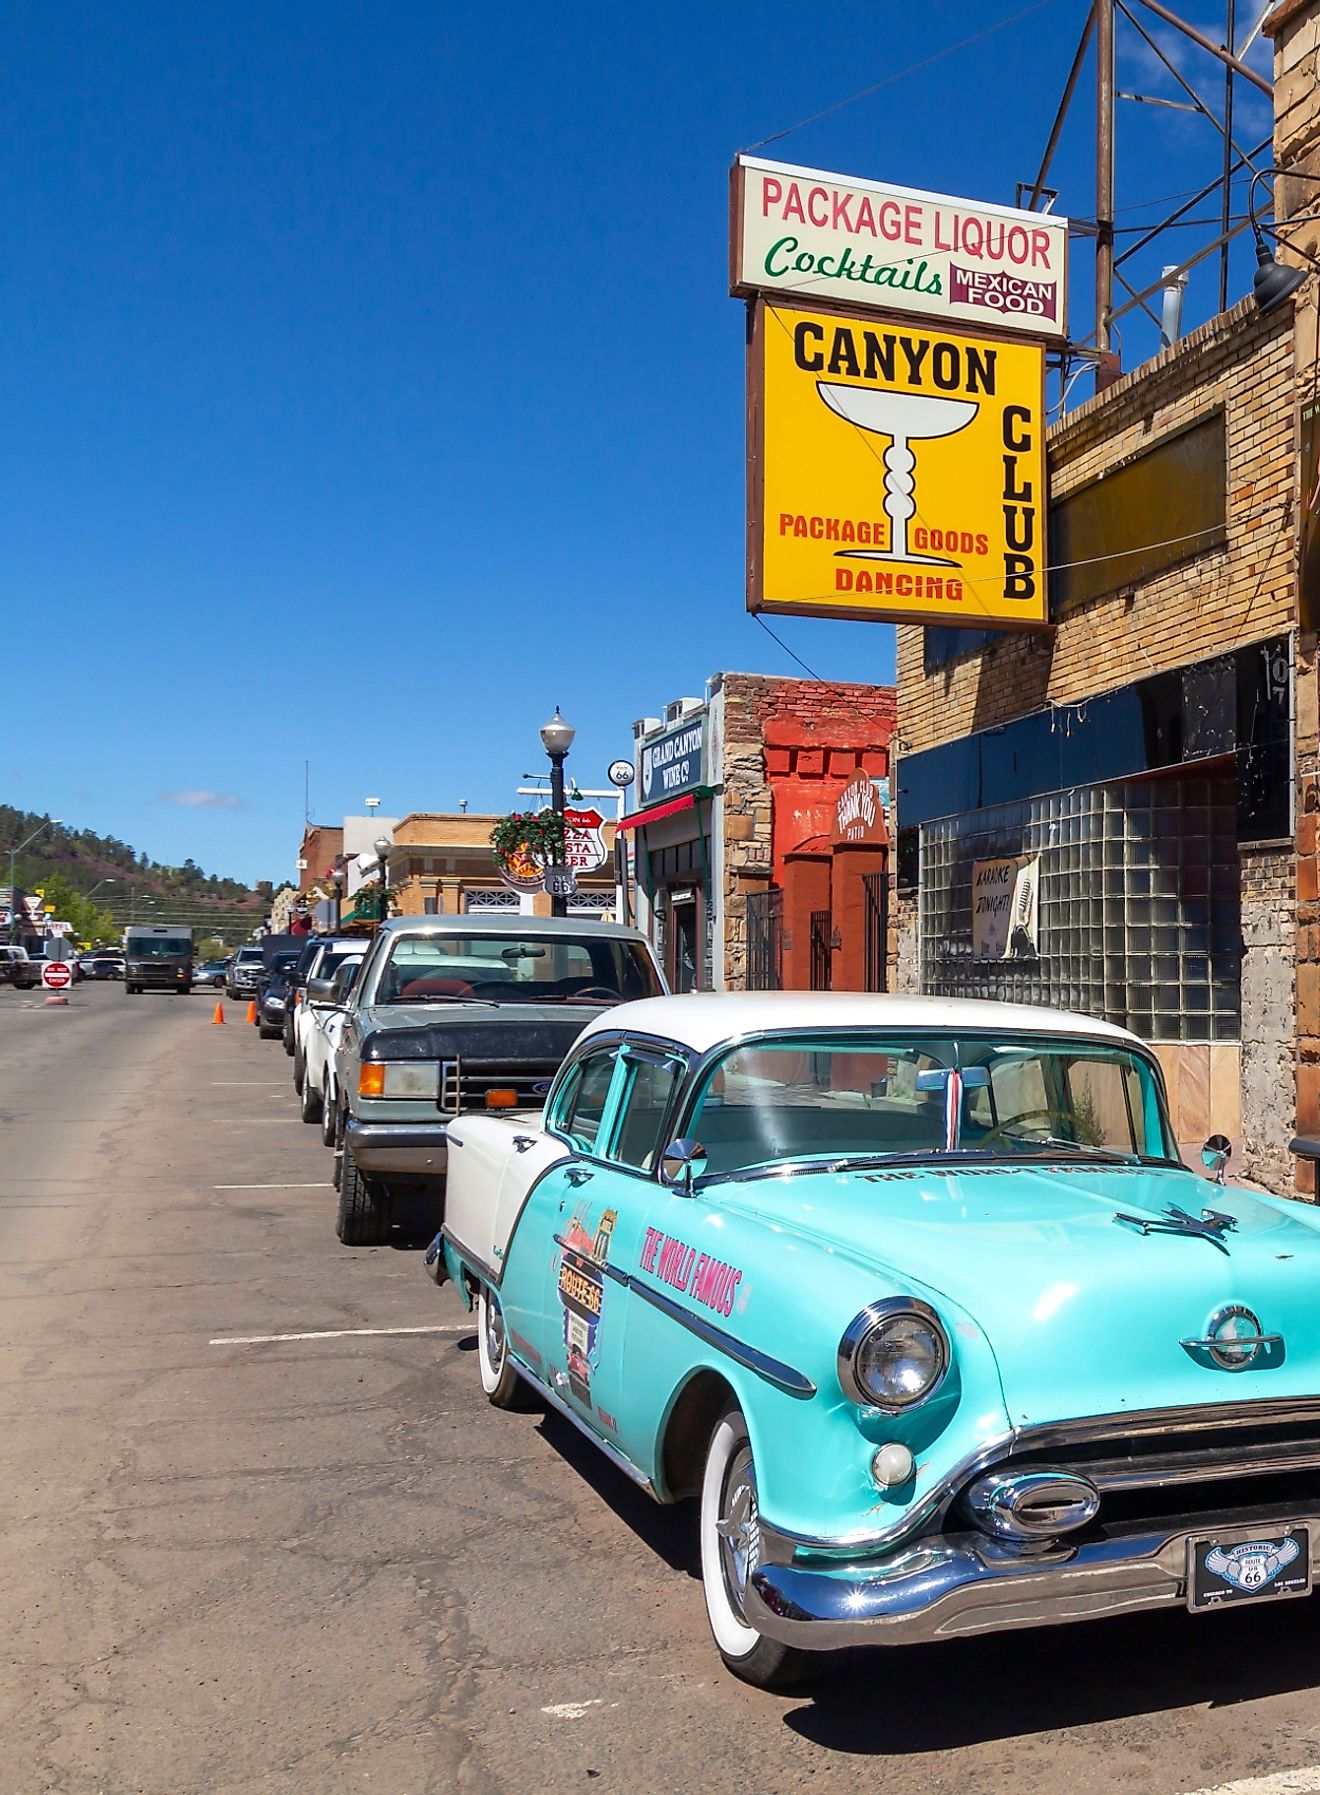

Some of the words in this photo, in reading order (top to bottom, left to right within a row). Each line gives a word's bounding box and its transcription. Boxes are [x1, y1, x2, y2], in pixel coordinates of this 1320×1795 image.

[762, 177, 923, 245] PACKAGE
[935, 210, 1051, 269] LIQUOR
[764, 236, 943, 296] Cocktails
[956, 269, 1053, 301] MEXICAN
[968, 287, 1044, 316] FOOD
[794, 322, 997, 396] CANYON
[1302, 408, 1314, 421] THE
[1002, 404, 1036, 600] CLUB
[779, 513, 885, 546] PACKAGE
[914, 527, 988, 556] GOODS
[835, 568, 963, 601] DANCING
[653, 741, 674, 768] GRAND
[674, 727, 702, 759] CANYON
[616, 770, 629, 780] 66
[662, 763, 681, 790] WINE
[838, 793, 861, 834] THANK
[861, 793, 876, 827] YOU
[565, 842, 591, 854] STA
[847, 825, 864, 841] PATIO
[553, 880, 569, 892] 66
[976, 865, 1010, 886] KARAOKE
[855, 1171, 925, 1184] THE
[931, 1166, 1039, 1178] WORLD
[640, 1226, 664, 1274] THE
[656, 1235, 697, 1292] WORLD
[689, 1252, 743, 1318] FAMOUS
[560, 1266, 589, 1303] ROUTE
[588, 1285, 601, 1313] 66
[1235, 1544, 1271, 1555] HISTORIC
[1244, 1572, 1261, 1584] 66
